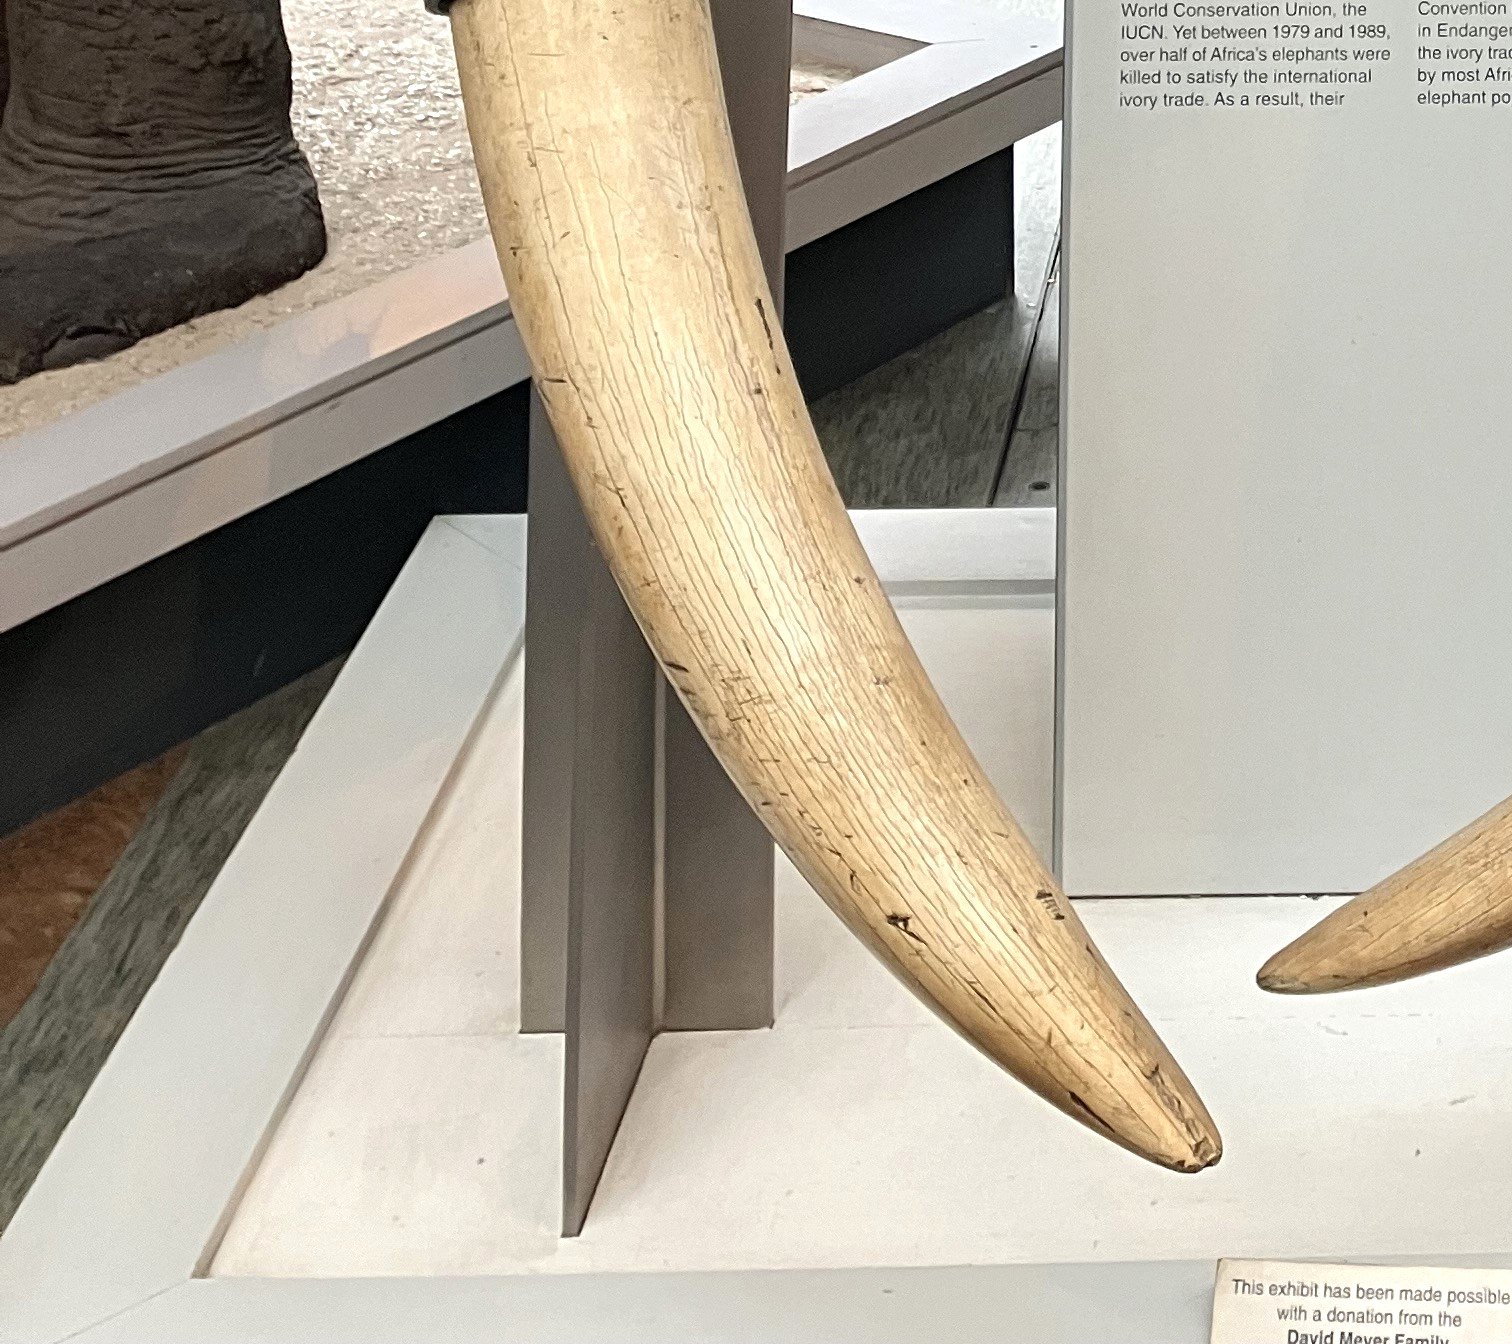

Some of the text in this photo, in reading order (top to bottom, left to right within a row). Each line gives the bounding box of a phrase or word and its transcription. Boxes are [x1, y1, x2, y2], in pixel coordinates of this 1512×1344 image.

[1121, 1, 1367, 18] World Conservation Union, the
[1231, 1279, 1510, 1307] This exhibit has been made possible
[1277, 1304, 1462, 1327] with a donation from the
[1287, 1329, 1334, 1344] David
